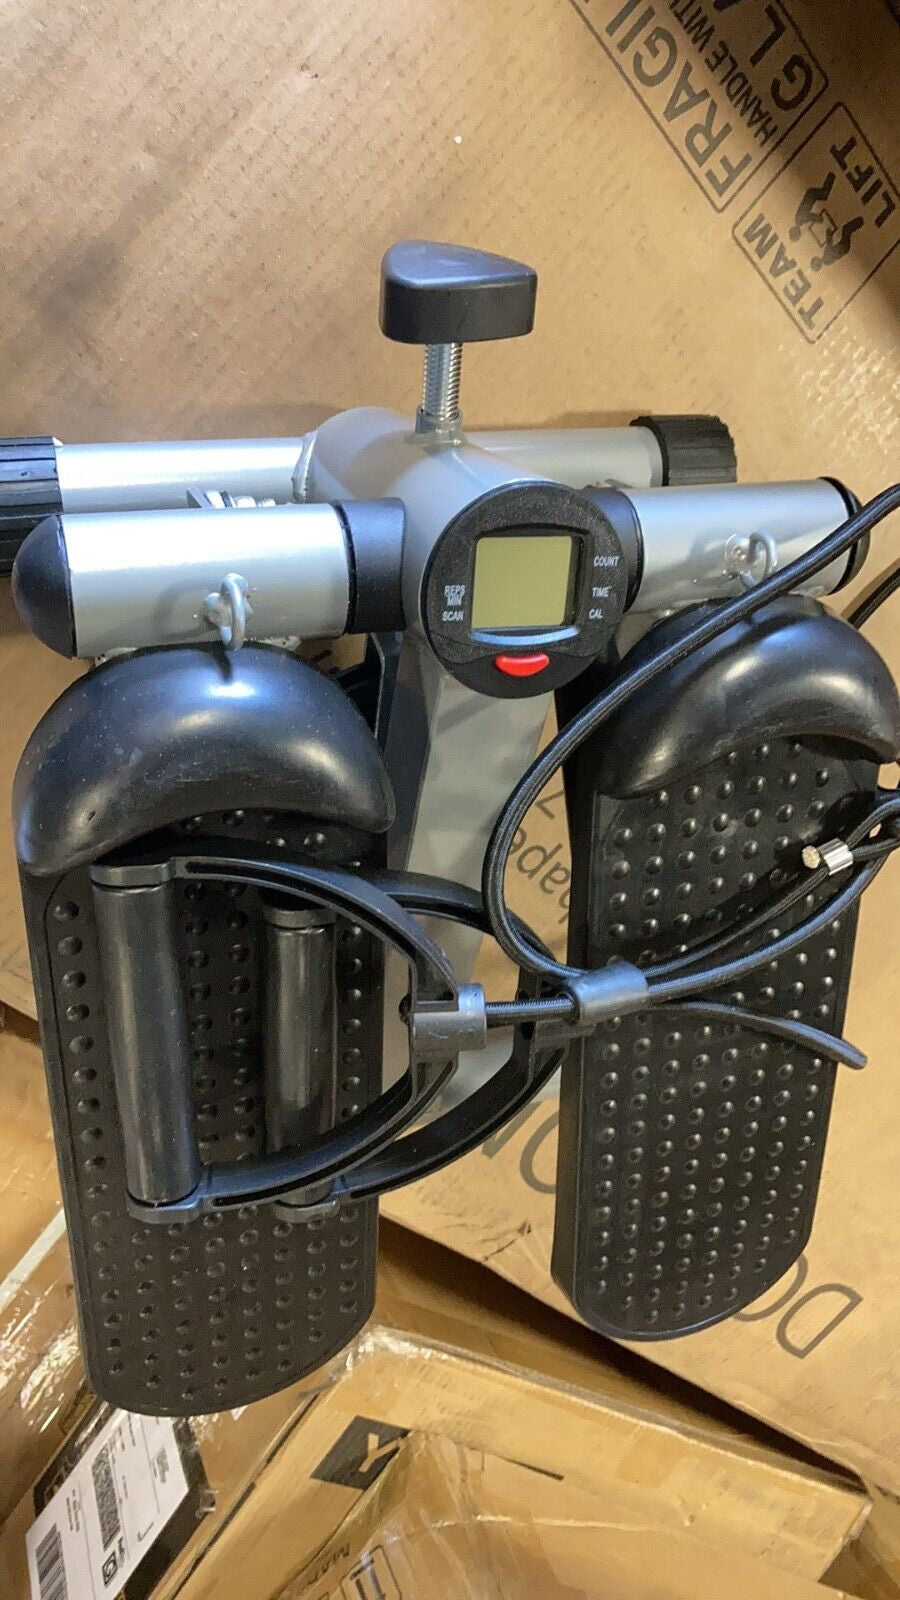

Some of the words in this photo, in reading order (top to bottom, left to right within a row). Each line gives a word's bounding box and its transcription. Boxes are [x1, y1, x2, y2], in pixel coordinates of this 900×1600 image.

[669, 0, 716, 53] WIT
[584, 0, 752, 198] FRAGIL
[704, 41, 778, 148] HANDLE
[829, 136, 896, 229] LIFT
[743, 213, 825, 330] TEAM
[593, 555, 620, 567] COUNT
[444, 585, 466, 597] REPS
[592, 586, 612, 598] TIME
[442, 610, 465, 622] SCAN
[589, 608, 604, 619] CAL
